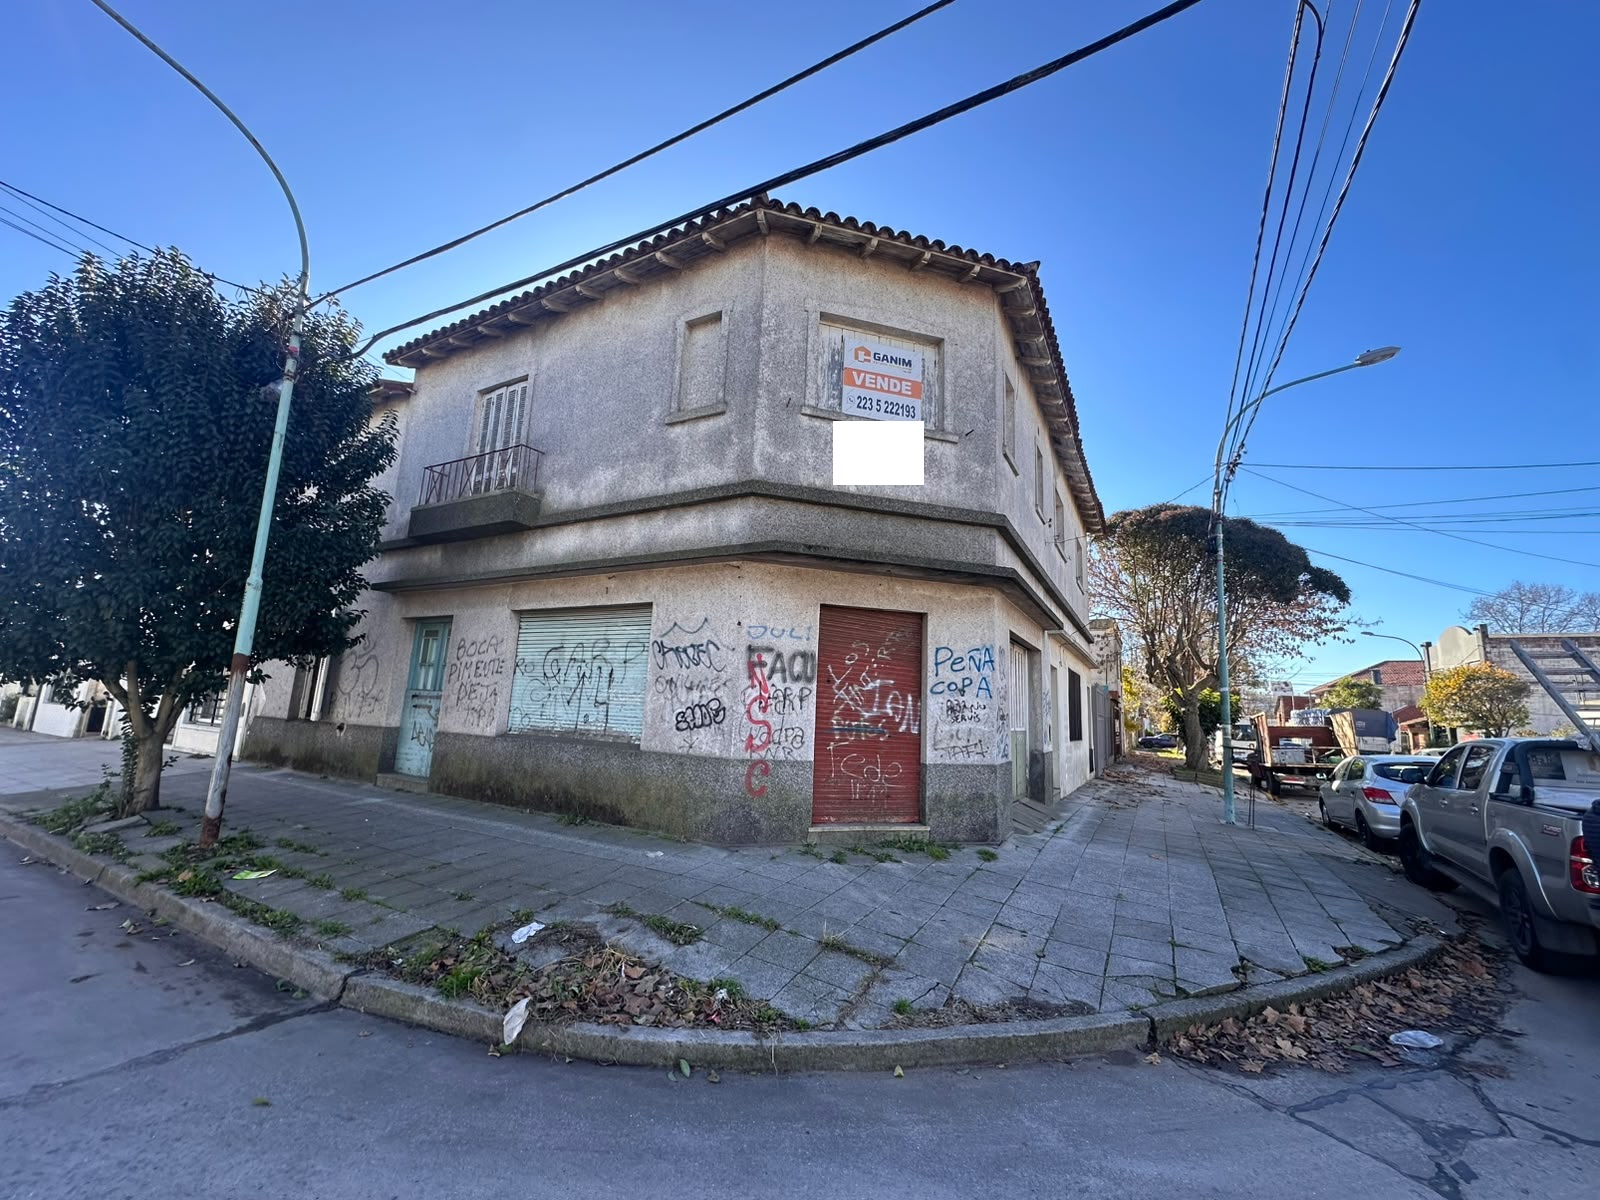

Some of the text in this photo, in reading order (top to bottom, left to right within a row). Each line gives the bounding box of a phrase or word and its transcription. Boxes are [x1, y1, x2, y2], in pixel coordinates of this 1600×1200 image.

[873, 352, 912, 369] GANIM
[852, 371, 912, 396] VENDE
[856, 395, 917, 419] 223 5 222193
